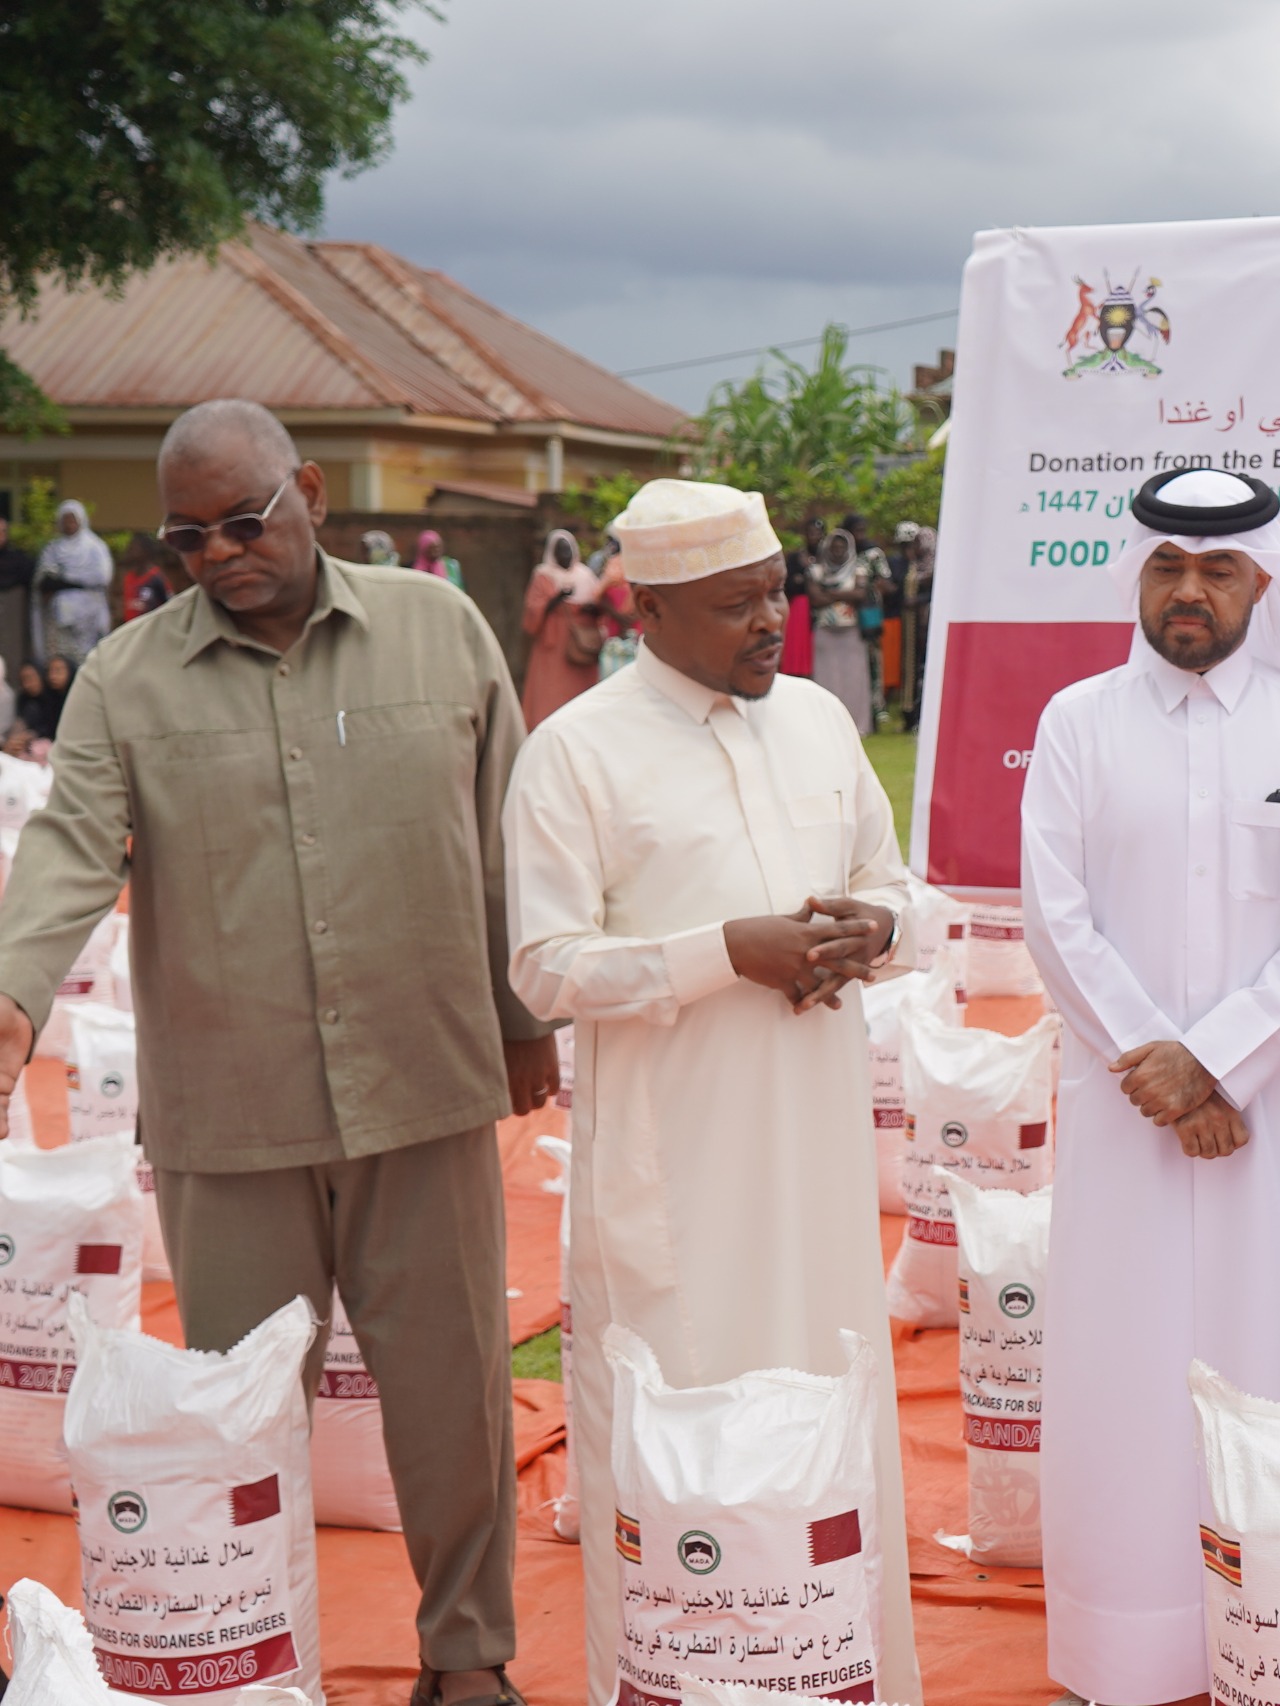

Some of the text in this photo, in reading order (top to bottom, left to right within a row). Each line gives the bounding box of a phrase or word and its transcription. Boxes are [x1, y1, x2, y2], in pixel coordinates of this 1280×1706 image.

[1029, 451, 1145, 474] Donation
[1153, 450, 1212, 470] from
[1223, 449, 1263, 469] the
[1036, 489, 1099, 513] 1447
[1029, 539, 1110, 567] FOOD
[335, 1373, 379, 1398] 202
[1004, 1399, 1025, 1413] FOR
[163, 1545, 211, 1573] غذائية
[218, 1540, 255, 1567] سلال
[688, 1557, 711, 1565] MADA
[153, 1593, 204, 1620] السفارة
[211, 1593, 233, 1616] من
[238, 1577, 273, 1613] تبرع
[682, 1587, 734, 1614] للاجئين
[743, 1586, 790, 1616] غذائية
[798, 1580, 835, 1609] سلال
[120, 1630, 142, 1650] FOR
[144, 1629, 216, 1650] SUDANESE
[219, 1611, 287, 1643] REFUGEES
[648, 1621, 855, 1663] تبرع من السفارة القطرية في
[98, 1650, 258, 1691] ANDA 2026
[801, 1659, 873, 1690] REFUGEES
[1249, 1655, 1266, 1687] في
[1213, 1672, 1231, 1699] FOOD
